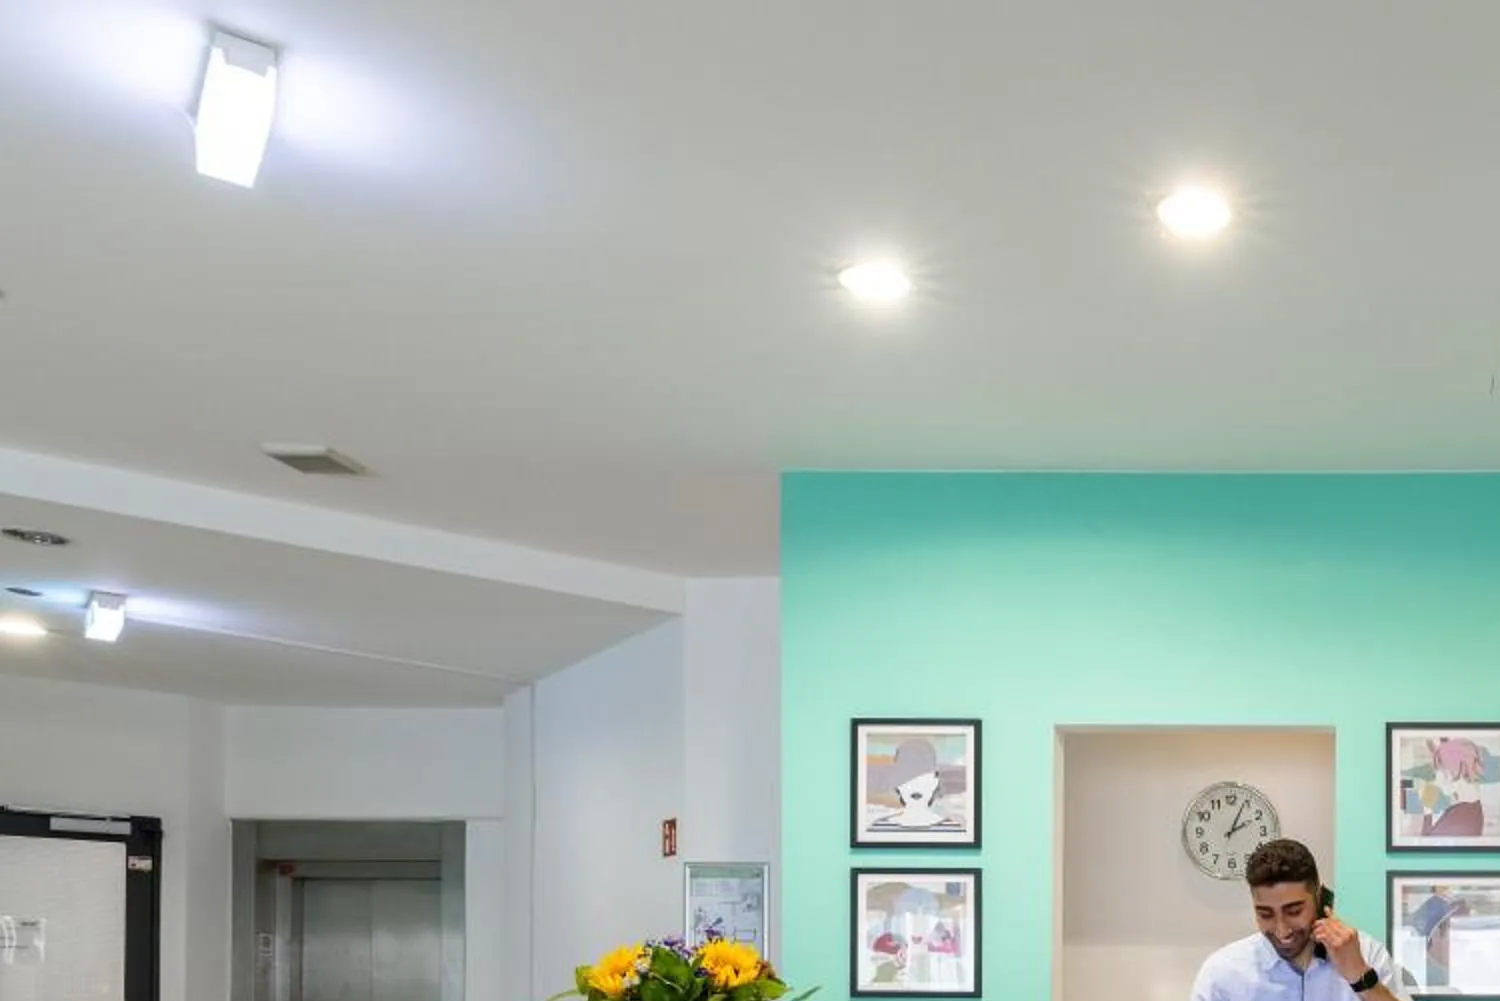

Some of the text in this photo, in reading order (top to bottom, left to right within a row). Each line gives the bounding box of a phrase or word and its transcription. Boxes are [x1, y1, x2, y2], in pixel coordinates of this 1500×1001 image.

[1211, 799, 1221, 811] 11
[1197, 811, 1211, 823] 10
[1255, 809, 1263, 821] 2
[1195, 826, 1204, 838] 9
[1259, 825, 1267, 837] 3
[1200, 842, 1209, 855] 8
[1211, 853, 1220, 865] 7
[1227, 857, 1237, 869] 6
